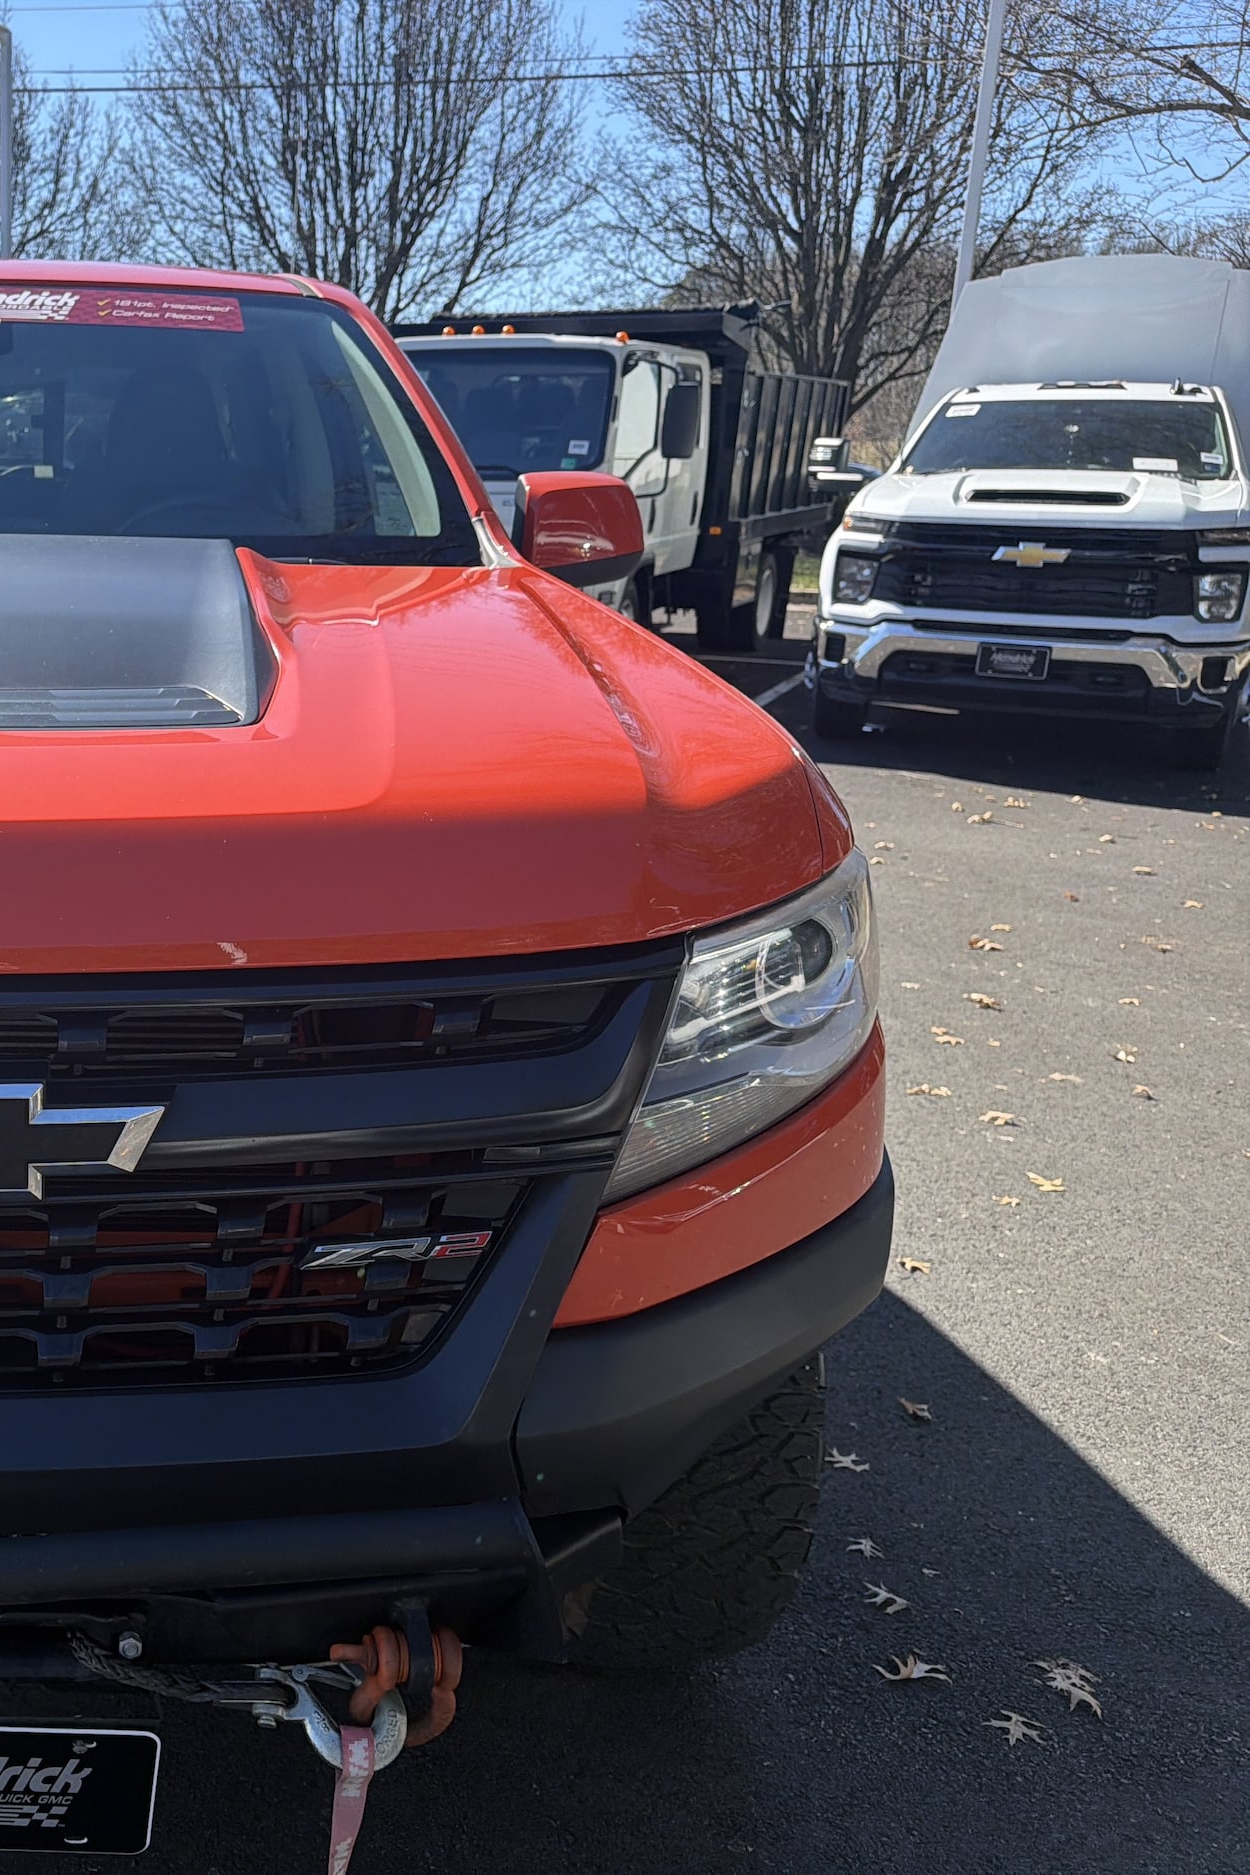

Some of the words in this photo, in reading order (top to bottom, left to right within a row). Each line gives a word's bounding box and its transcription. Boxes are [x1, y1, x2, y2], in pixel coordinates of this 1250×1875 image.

[112, 309, 161, 319] Carfax
[164, 312, 216, 322] Report
[301, 1231, 494, 1270] ZR2
[38, 1795, 73, 1805] GMC
